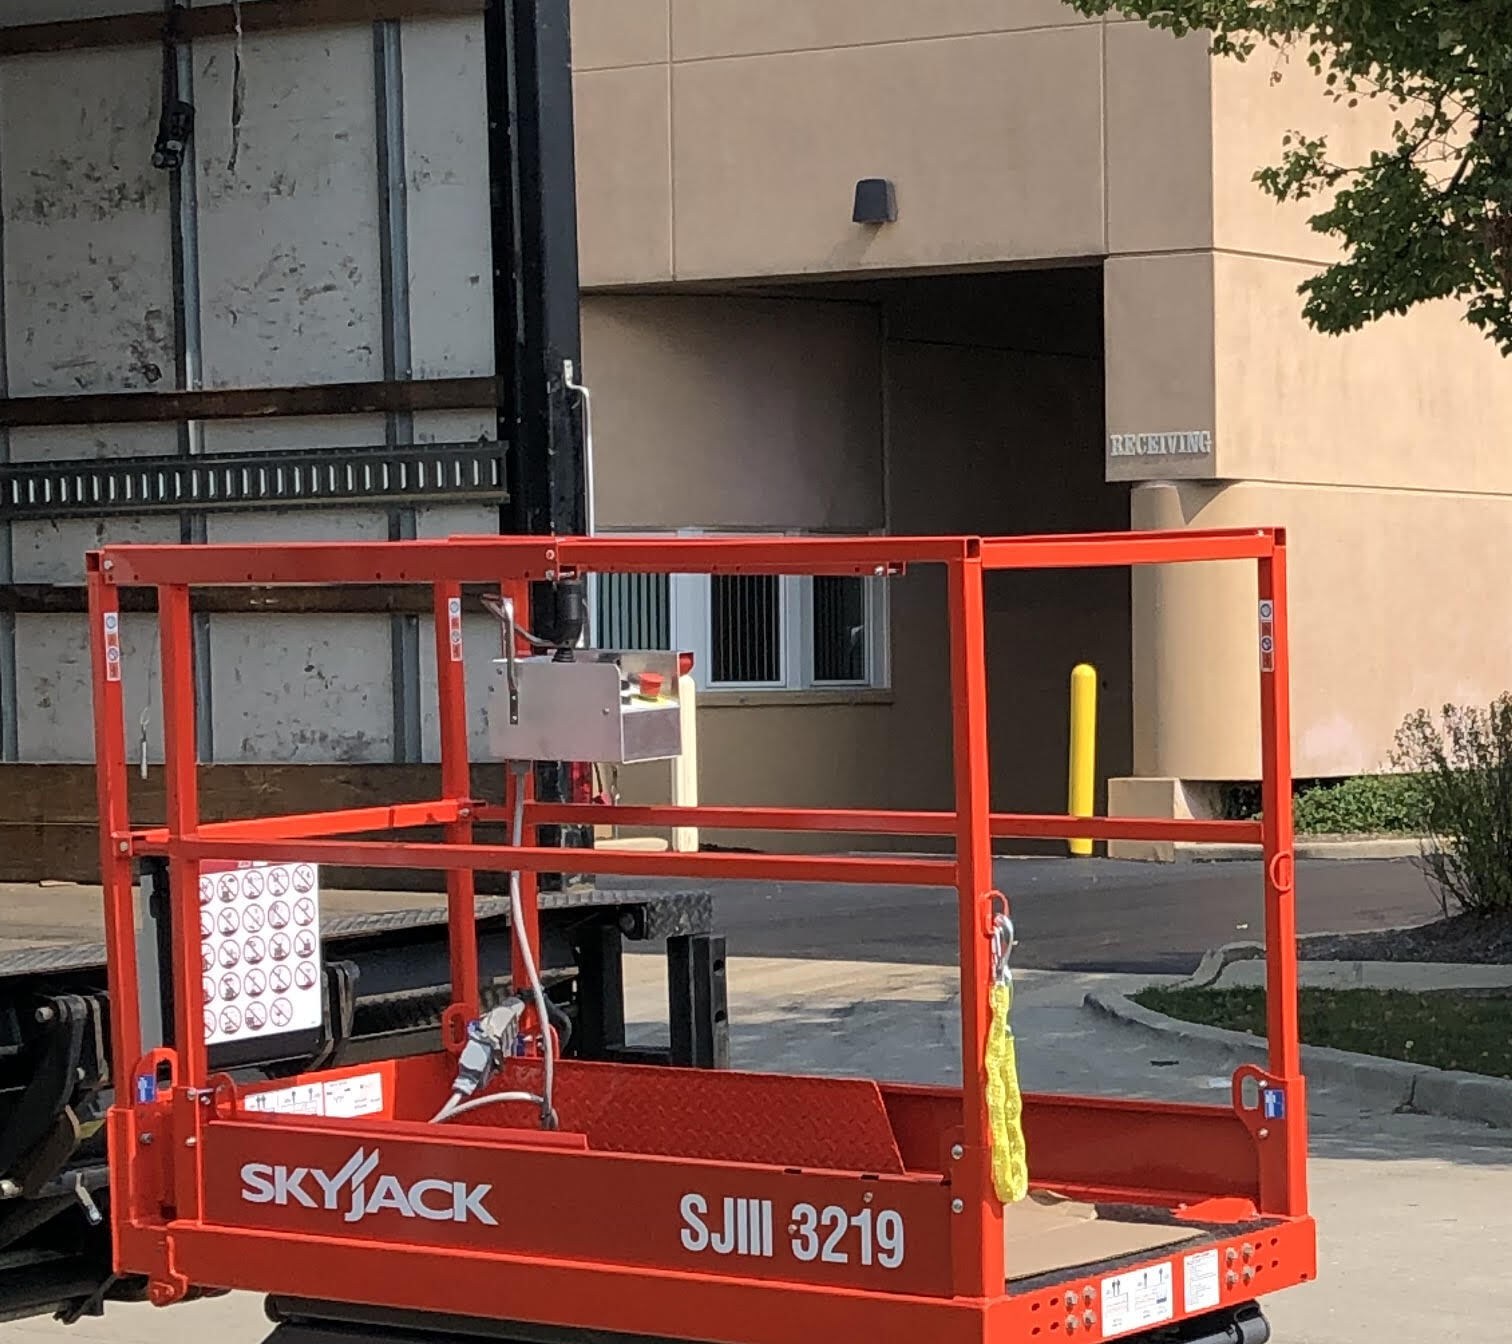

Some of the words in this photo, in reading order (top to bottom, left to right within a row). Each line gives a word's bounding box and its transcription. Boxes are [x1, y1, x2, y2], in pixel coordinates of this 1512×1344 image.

[1110, 430, 1212, 456] RECEIVING
[241, 1146, 499, 1226] SKYJACK
[680, 1193, 773, 1257] SJIII
[790, 1202, 904, 1269] 3219
